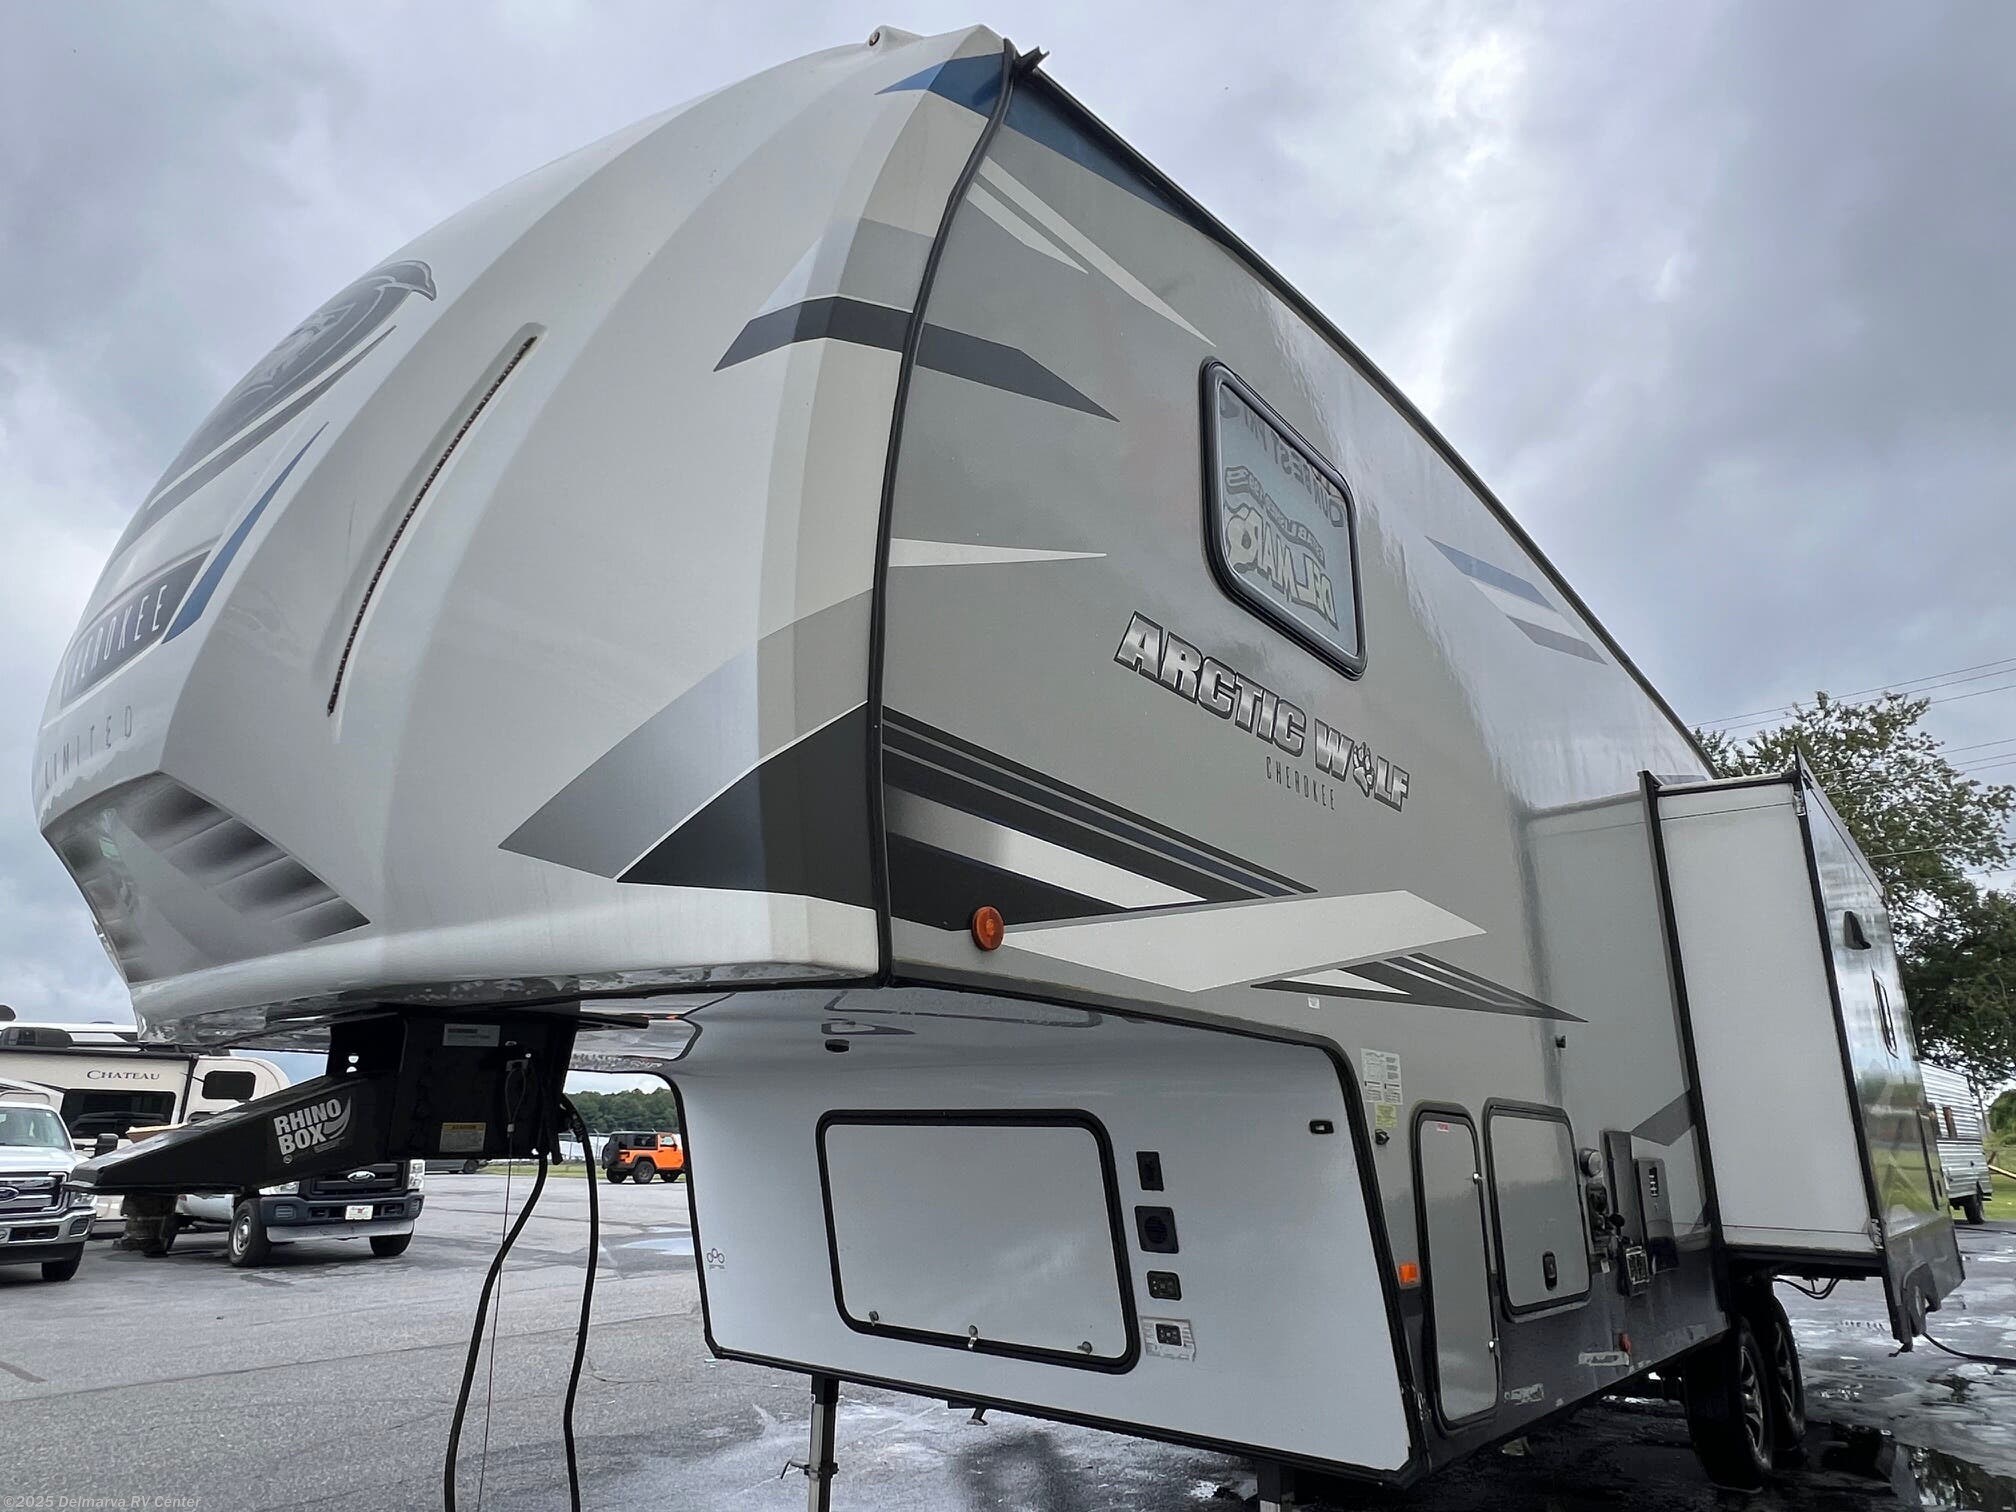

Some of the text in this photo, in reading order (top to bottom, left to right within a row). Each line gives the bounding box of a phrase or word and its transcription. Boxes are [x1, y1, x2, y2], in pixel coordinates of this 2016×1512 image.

[1113, 610, 1307, 758] ARCTIC
[44, 704, 133, 790] LIMITED
[1266, 756, 1336, 811] CHEROKEE
[273, 1098, 342, 1136] RHINO
[278, 1122, 327, 1156] BOX
